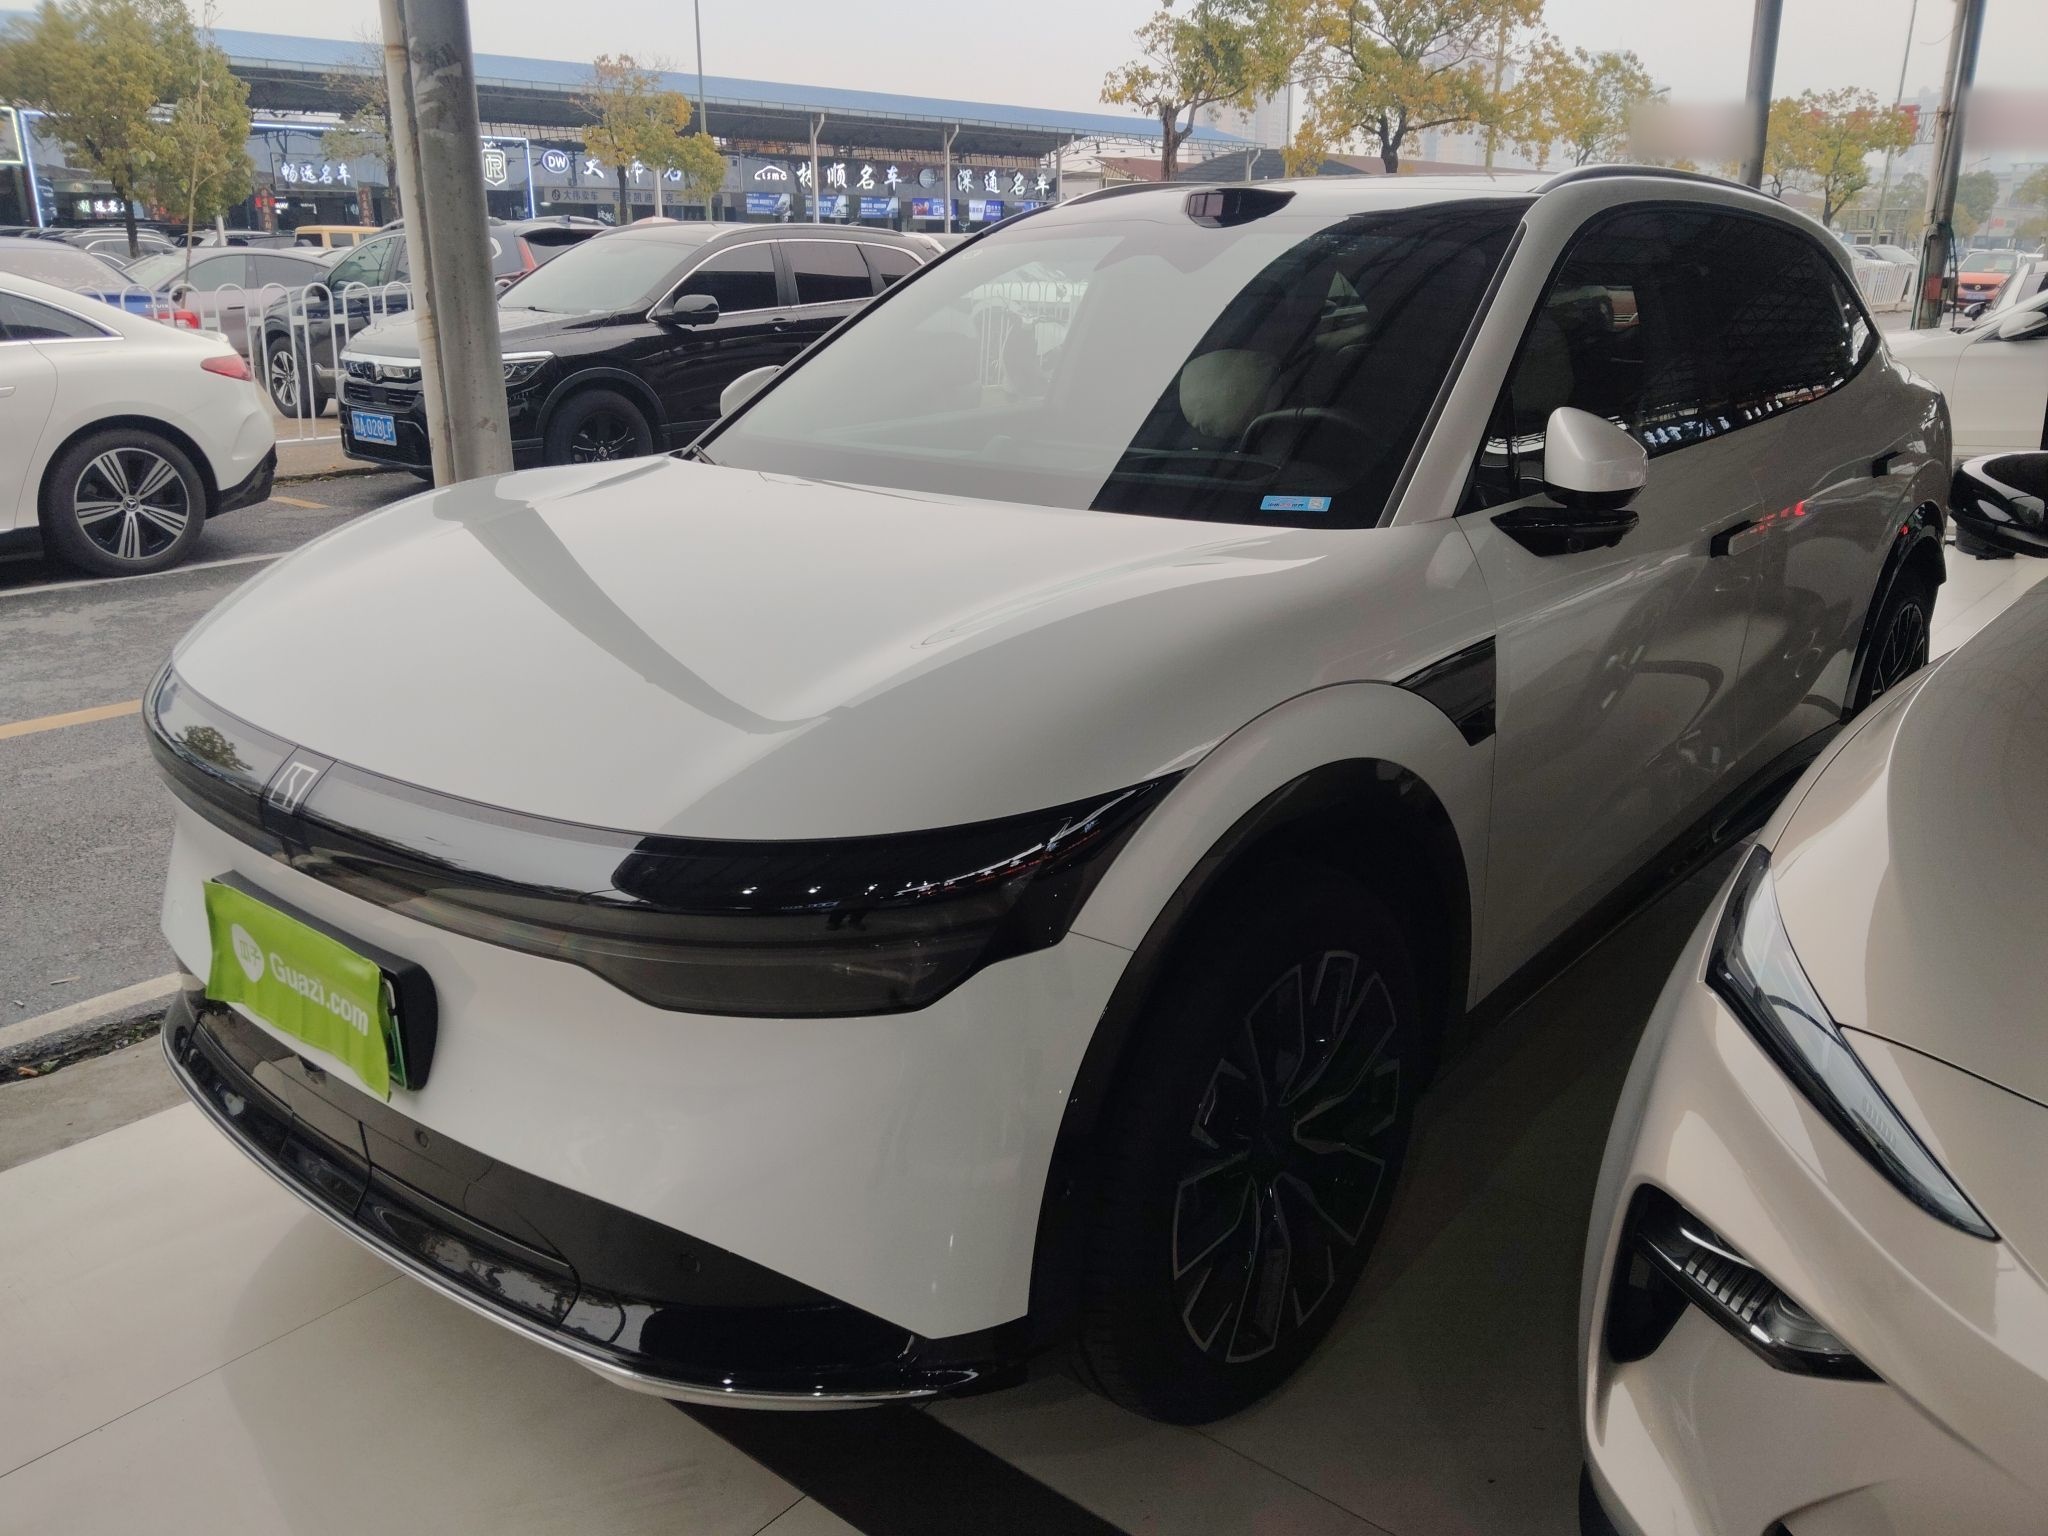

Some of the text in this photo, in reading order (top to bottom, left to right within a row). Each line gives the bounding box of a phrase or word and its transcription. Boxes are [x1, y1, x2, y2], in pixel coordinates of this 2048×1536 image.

[281, 162, 351, 186] 畅远名车
[548, 155, 566, 168] DW
[957, 168, 1050, 196] 深通名车
[269, 952, 368, 1037] Guazi.com
